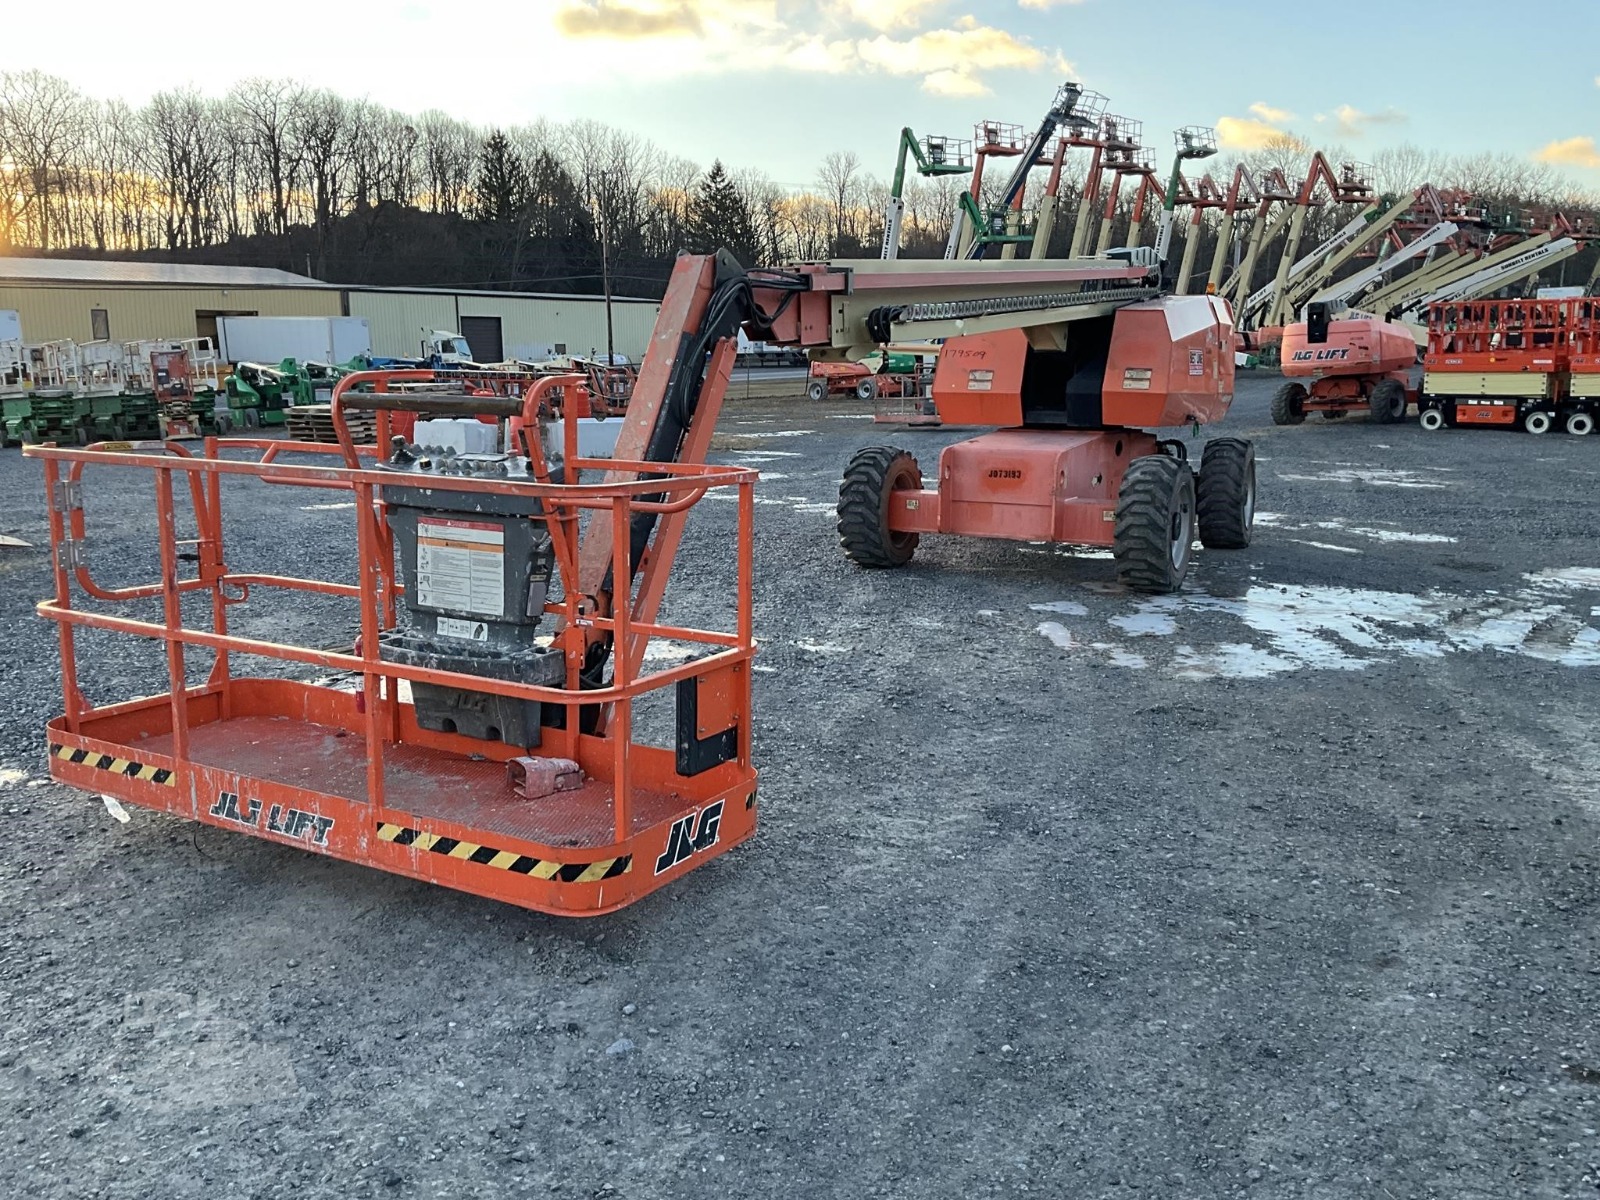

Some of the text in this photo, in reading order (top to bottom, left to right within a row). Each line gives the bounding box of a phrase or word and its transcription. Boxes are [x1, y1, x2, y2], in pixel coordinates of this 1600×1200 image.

[1500, 247, 1549, 270] SUNBELT RENTALS
[944, 349, 986, 360] 179509
[1292, 347, 1349, 362] JLG LIFT
[265, 803, 336, 846] LIFT
[653, 798, 725, 877] JLG
